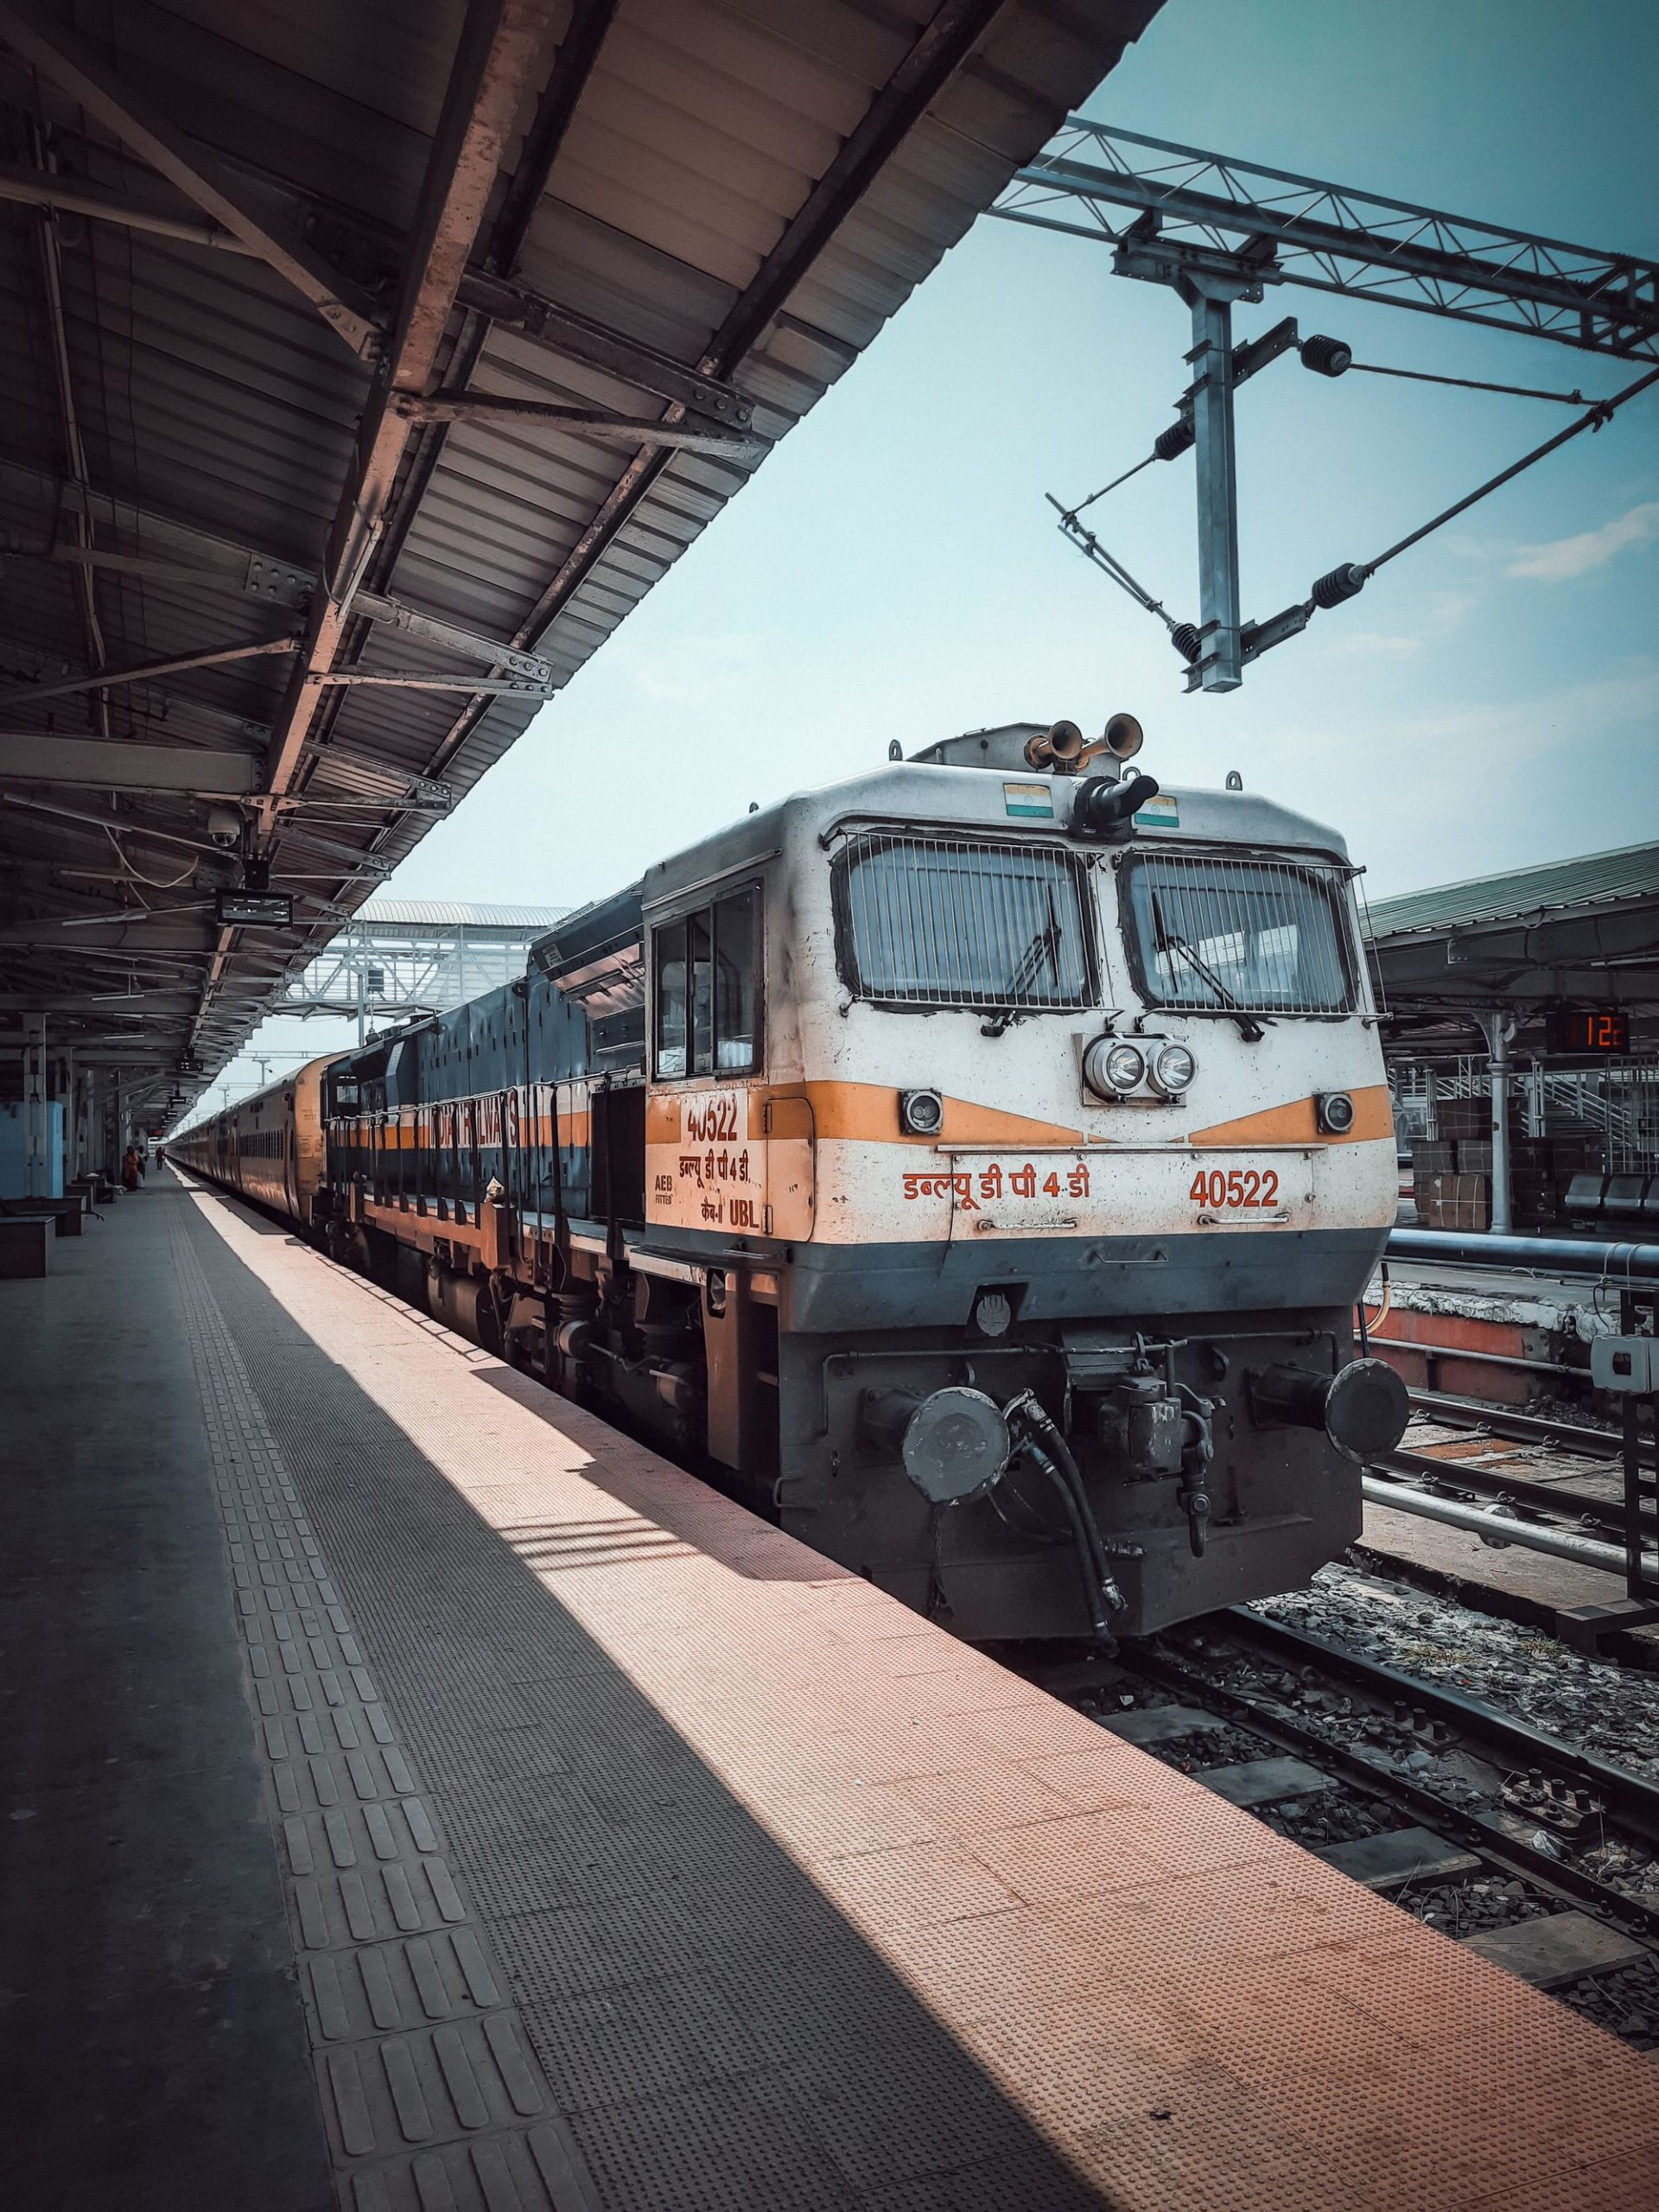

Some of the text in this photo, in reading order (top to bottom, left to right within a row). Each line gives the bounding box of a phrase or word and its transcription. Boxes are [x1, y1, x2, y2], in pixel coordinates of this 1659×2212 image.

[687, 1095, 738, 1141] 40522
[705, 1148, 715, 1179] डी
[717, 1148, 728, 1180] पी
[730, 1158, 737, 1181] 4
[655, 1174, 672, 1191] AEB
[903, 1163, 1090, 1210] डब्ल्यू डी पी 4 डी
[1190, 1170, 1279, 1207] 40522
[655, 1194, 672, 1205] FITTED
[729, 1198, 760, 1228] UBL
